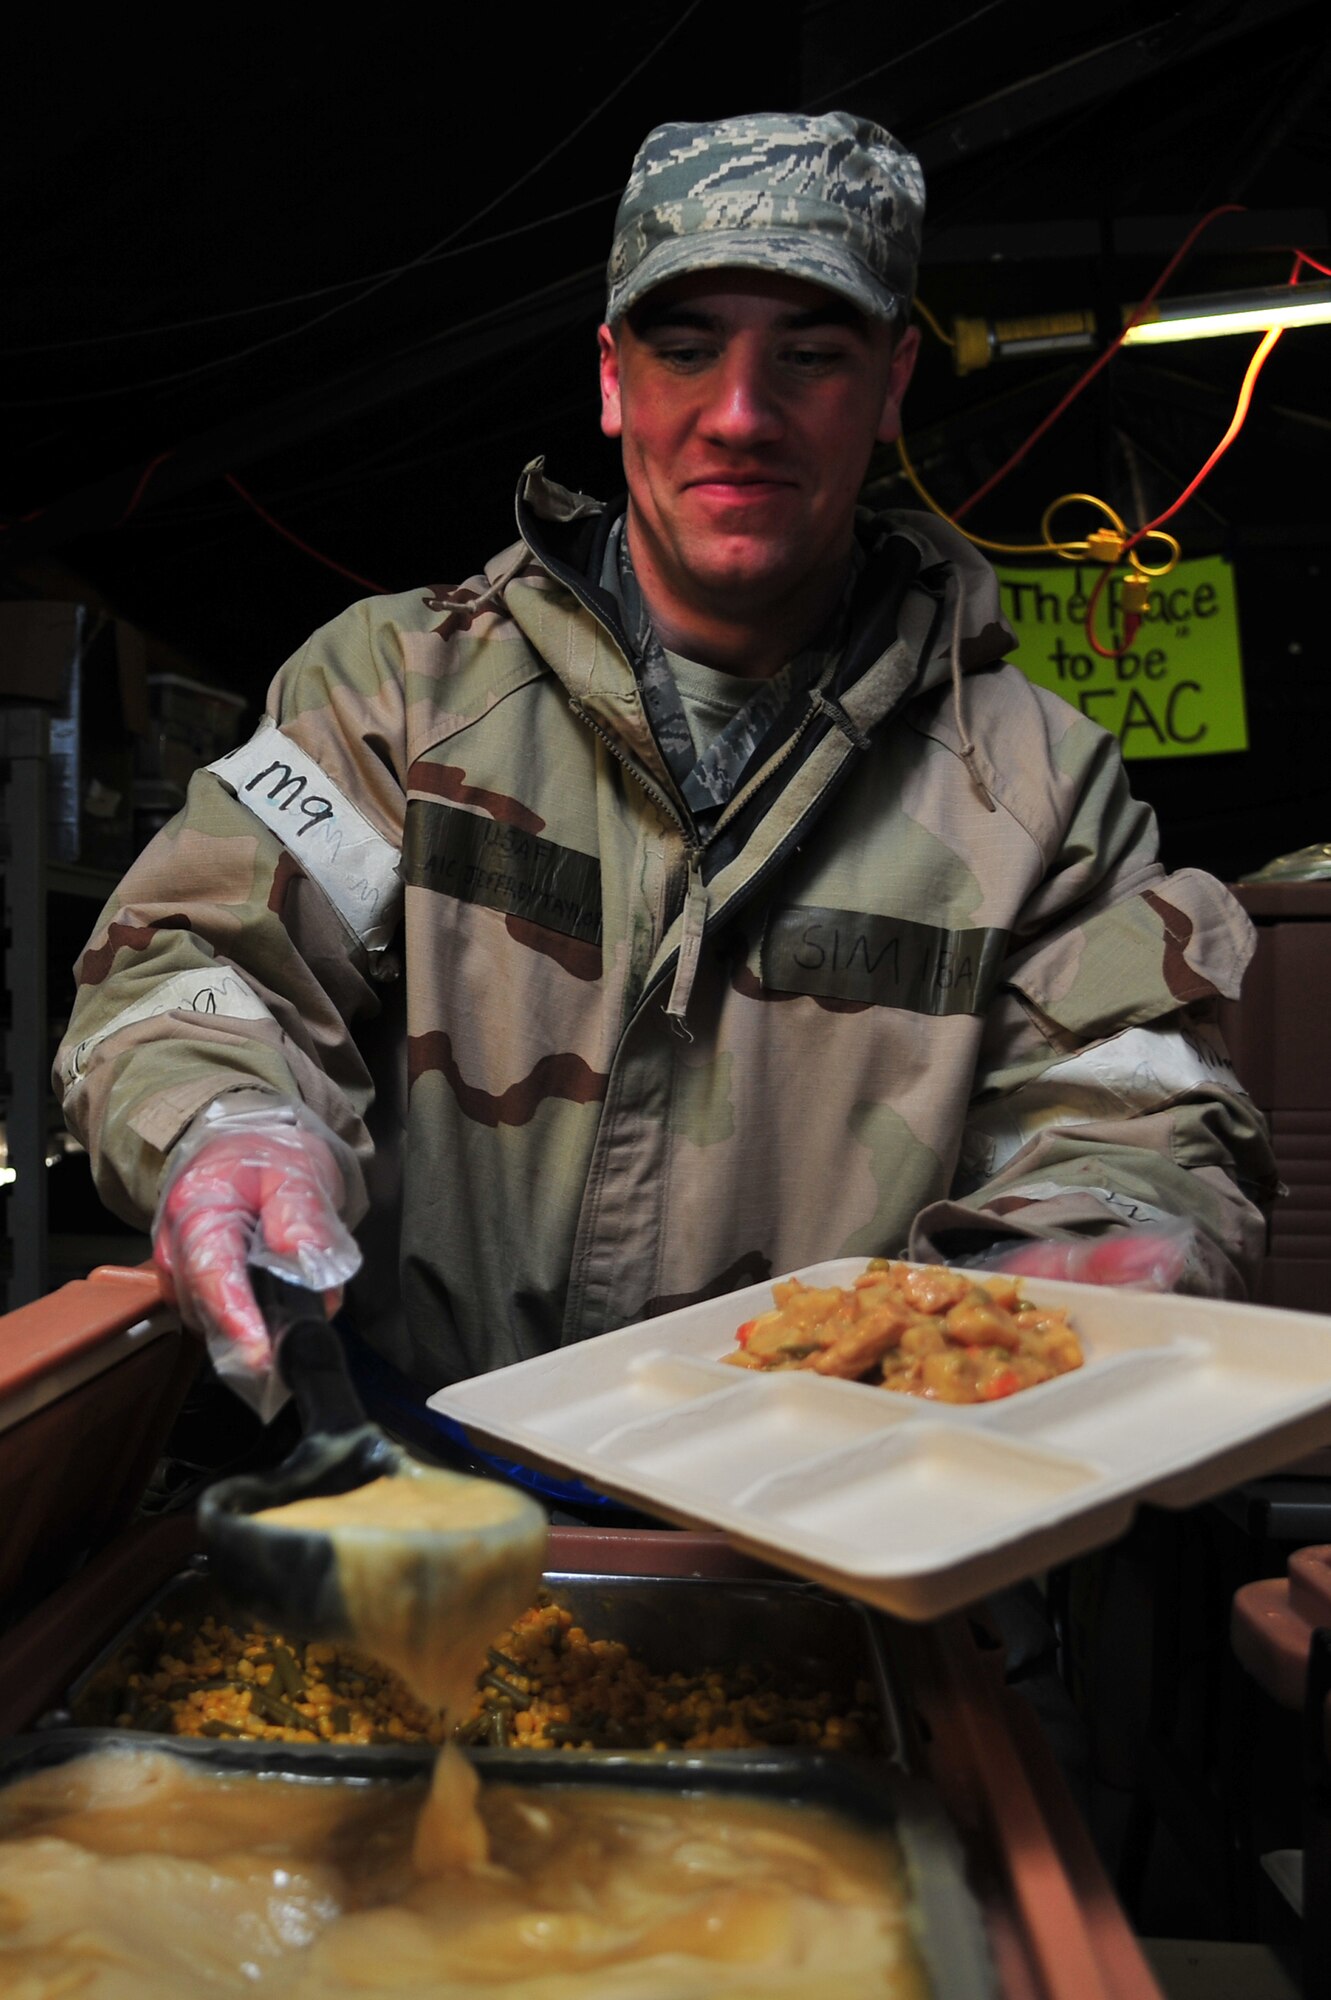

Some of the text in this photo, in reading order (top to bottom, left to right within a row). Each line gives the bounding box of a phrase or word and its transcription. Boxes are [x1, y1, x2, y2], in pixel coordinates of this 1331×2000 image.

[1001, 581, 1088, 624] The
[1049, 634, 1167, 681] to be
[794, 924, 899, 986] SIM
